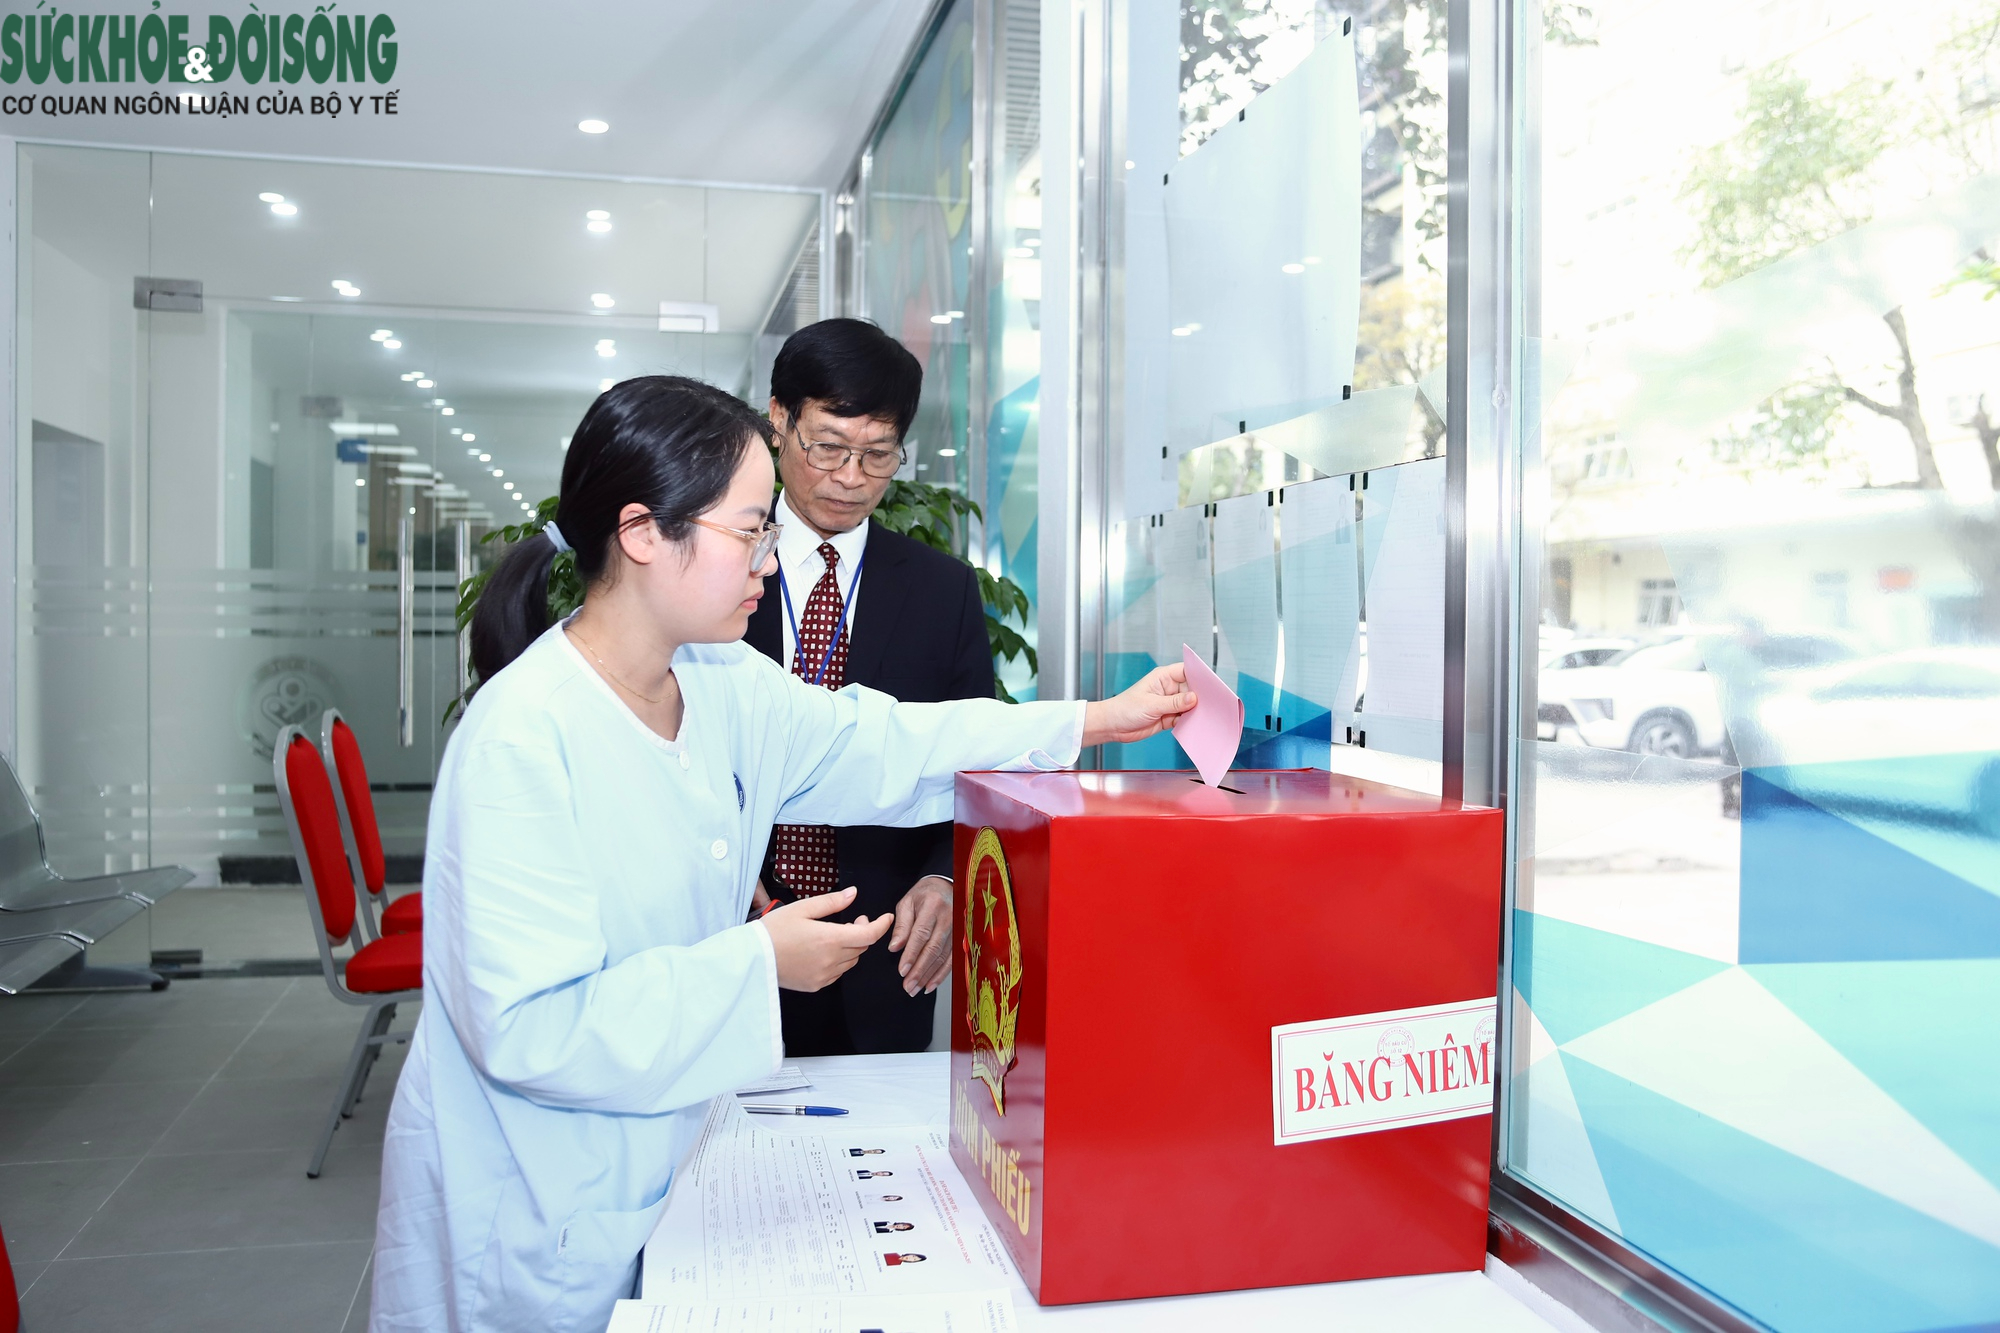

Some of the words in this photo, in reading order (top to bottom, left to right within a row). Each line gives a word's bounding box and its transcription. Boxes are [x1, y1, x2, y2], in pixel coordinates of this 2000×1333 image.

[1293, 1051, 1393, 1113] BĂNG
[1403, 1033, 1491, 1097] NIÊM
[955, 1079, 979, 1166] HÒM
[982, 1124, 1031, 1236] PHIẾU
